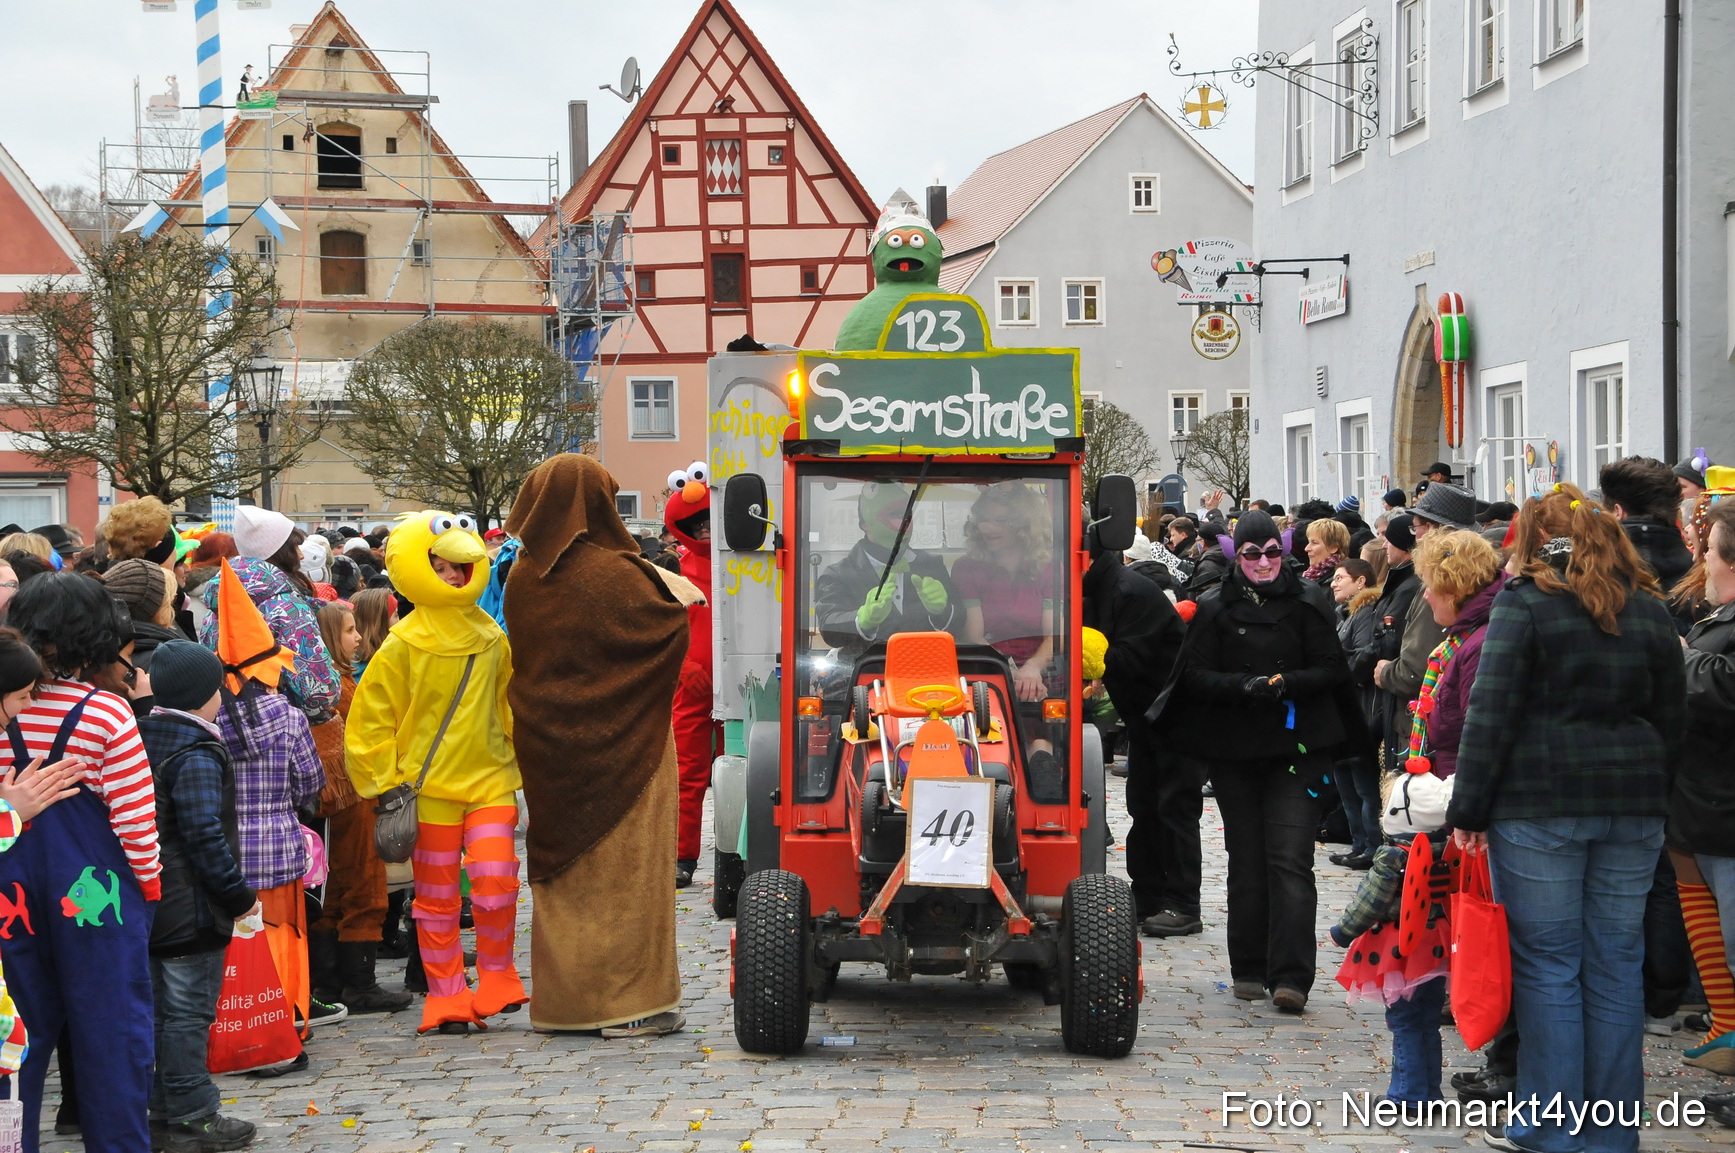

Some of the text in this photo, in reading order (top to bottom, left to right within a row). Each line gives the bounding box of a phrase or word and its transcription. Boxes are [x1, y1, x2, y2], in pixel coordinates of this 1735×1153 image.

[1194, 240, 1235, 250] Pizzeria
[1204, 253, 1225, 264] Café
[896, 309, 966, 352] 123
[808, 363, 1070, 442] Sesamstraße
[920, 809, 975, 847] 40
[258, 987, 285, 1003] obe
